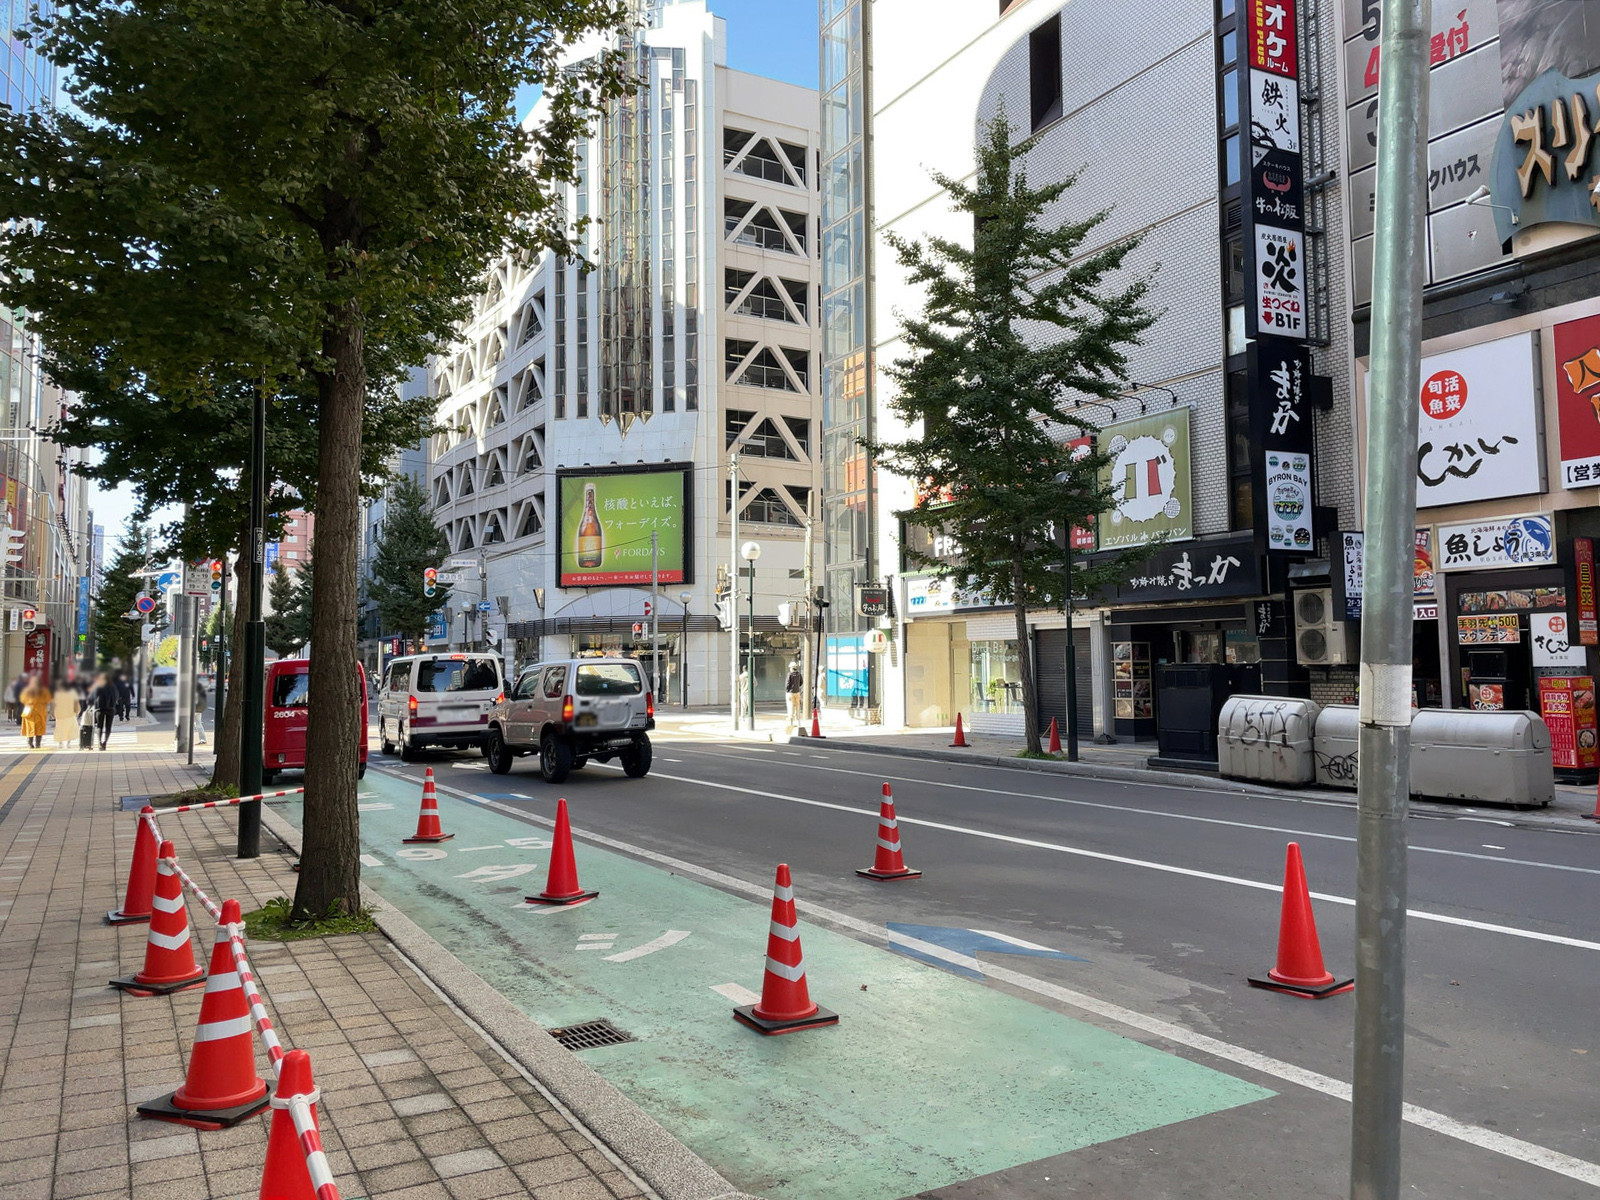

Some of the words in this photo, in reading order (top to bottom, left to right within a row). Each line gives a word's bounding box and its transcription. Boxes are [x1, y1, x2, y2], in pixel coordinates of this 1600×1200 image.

[1256, 30, 1265, 65] PLUS
[1267, 57, 1289, 72] ルーム
[1287, 139, 1297, 150] 3F
[1510, 83, 1600, 199] スリ
[1262, 160, 1292, 172] ステーキハウス
[1428, 153, 1482, 192] クハウス
[1260, 232, 1288, 244] 炭火居酒屋
[1262, 295, 1300, 313] 生つくね
[1275, 312, 1301, 330] B1F
[1269, 360, 1300, 435] まっか
[1268, 472, 1292, 487] BYRON
[1292, 474, 1308, 487] BAY
[604, 495, 677, 511] 核酸といえば、
[605, 515, 677, 530] フォーデイズ。
[1470, 525, 1495, 534] 北海海鮮
[1104, 533, 1138, 546] エゾバル
[1444, 532, 1521, 563] 魚しょう
[1344, 535, 1356, 588] 魚しょう
[1171, 552, 1241, 591] まっか
[1129, 574, 1176, 590] お好み焼き
[1419, 609, 1437, 618] 入口
[1498, 615, 1517, 627] 500
[1458, 618, 1489, 629] 手羽先
[1459, 631, 1508, 641] マウンテン
[273, 711, 295, 719] 2604
